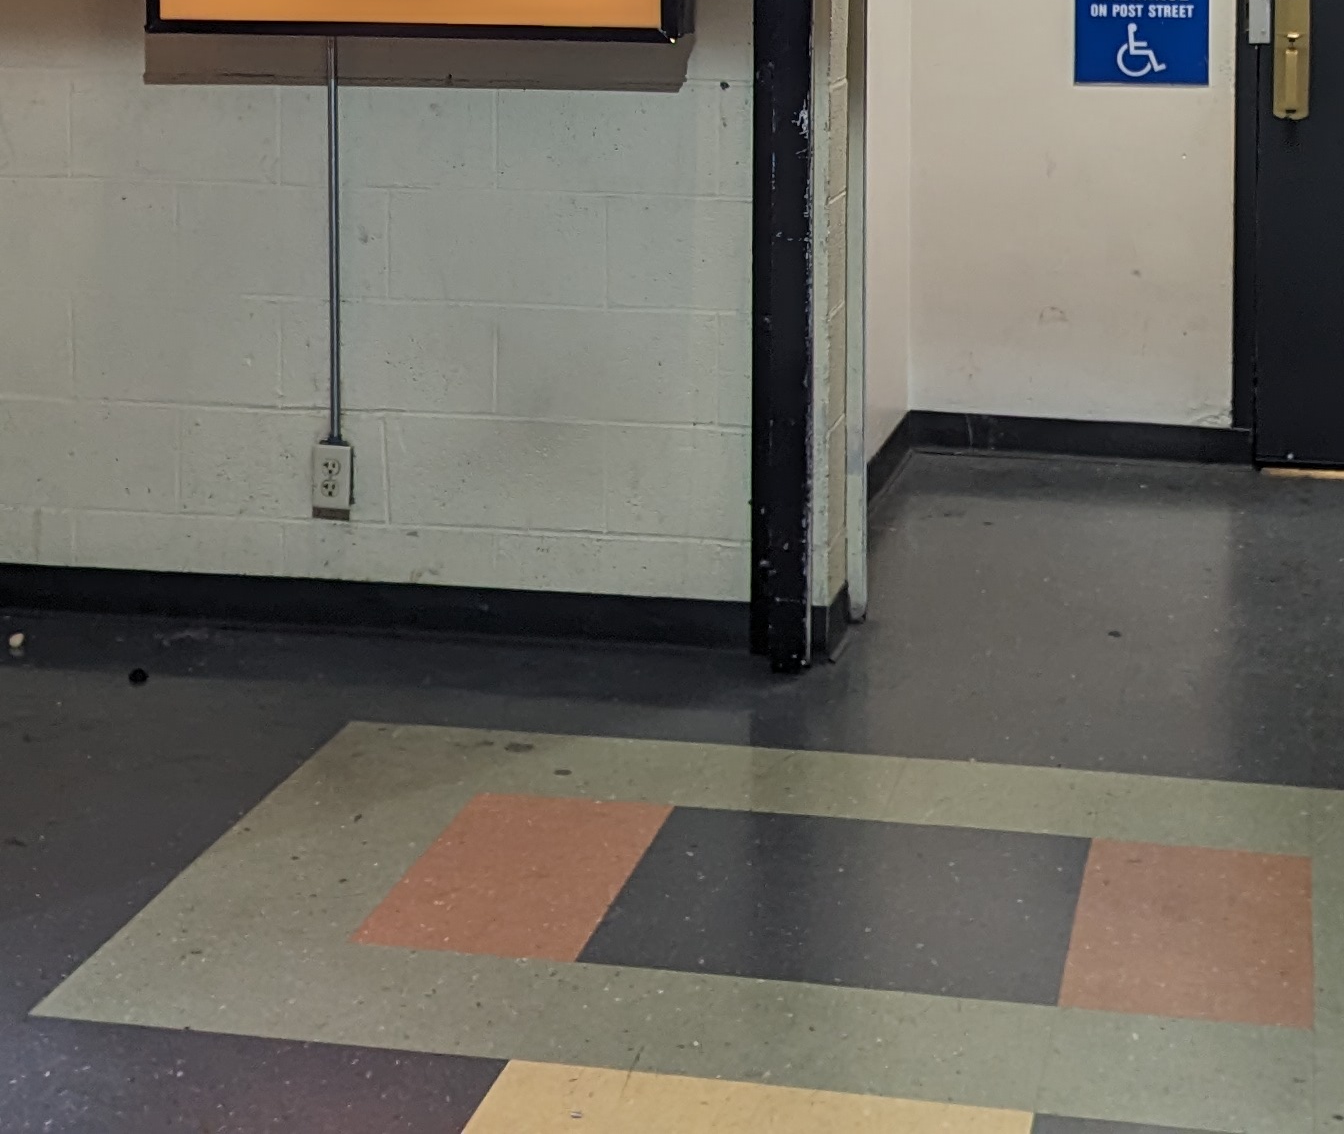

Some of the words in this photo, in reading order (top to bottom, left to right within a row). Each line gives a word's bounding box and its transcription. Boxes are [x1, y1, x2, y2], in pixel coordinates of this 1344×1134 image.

[1090, 4, 1107, 17] ON
[1112, 4, 1144, 17] POST
[1148, 5, 1194, 18] STREET
